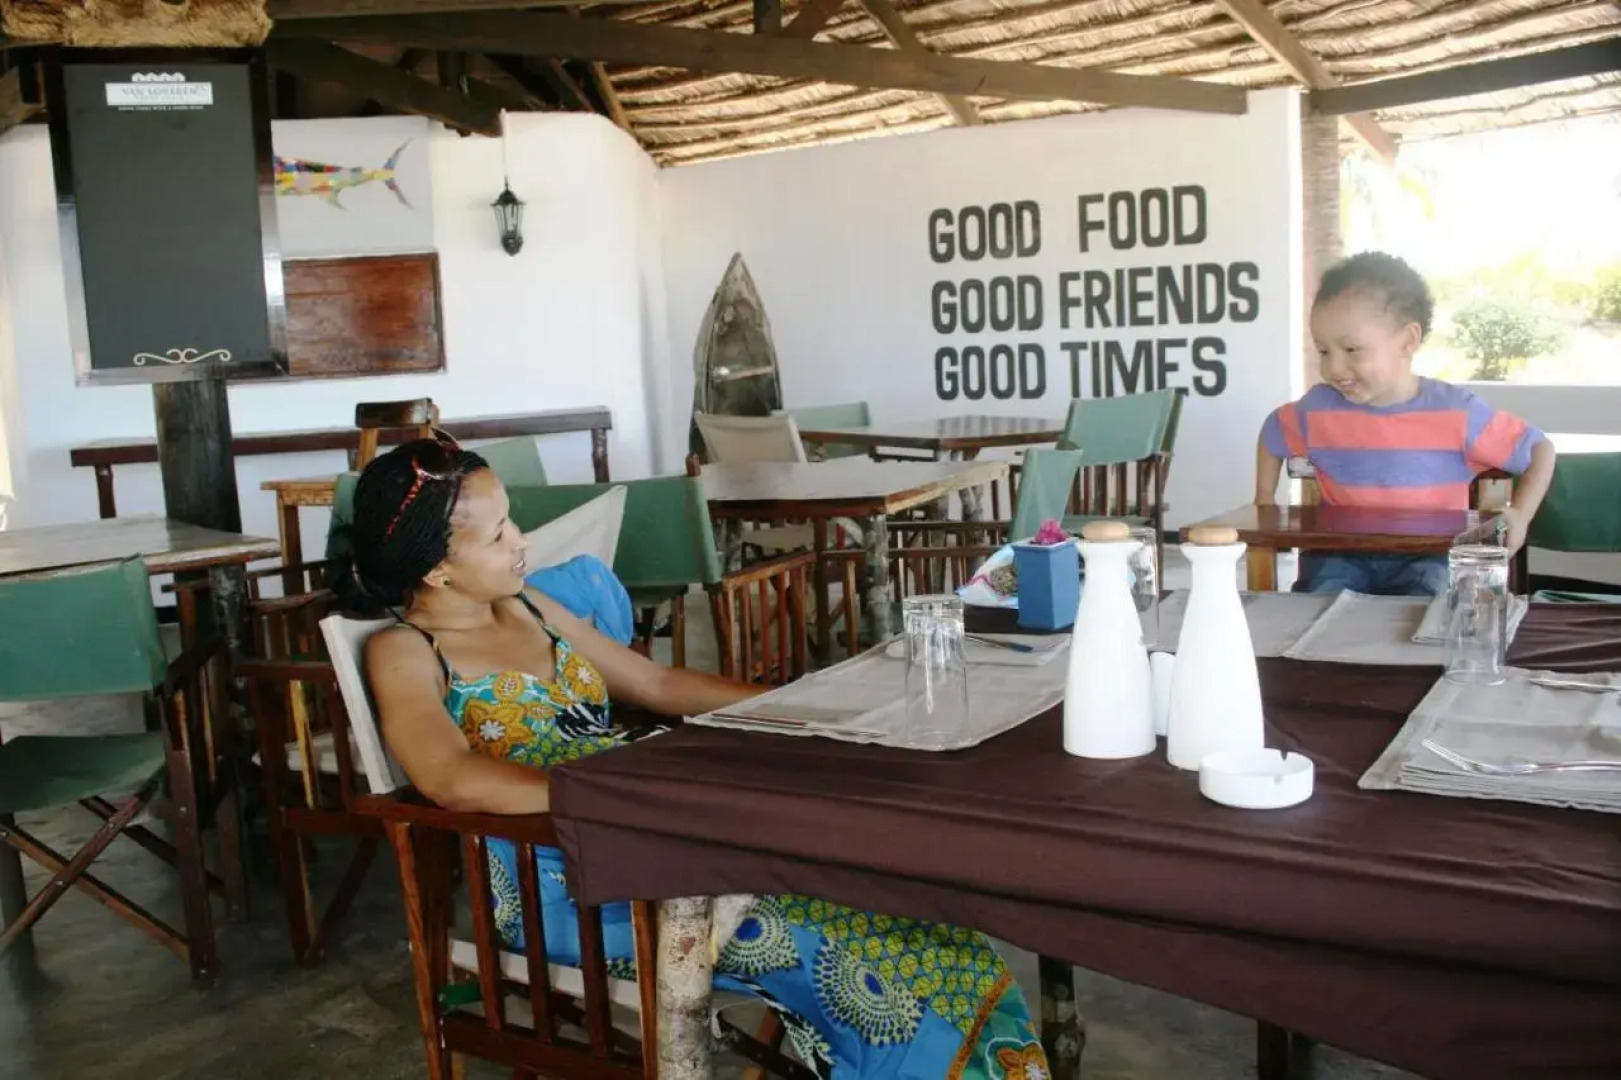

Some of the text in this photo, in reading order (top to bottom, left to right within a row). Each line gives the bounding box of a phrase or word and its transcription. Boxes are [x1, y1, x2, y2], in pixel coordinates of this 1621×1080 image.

[928, 185, 1207, 264] GOOD FOOD
[931, 262, 1259, 335] GOOD FRIENDS
[934, 337, 1227, 401] GOOD TIMES
